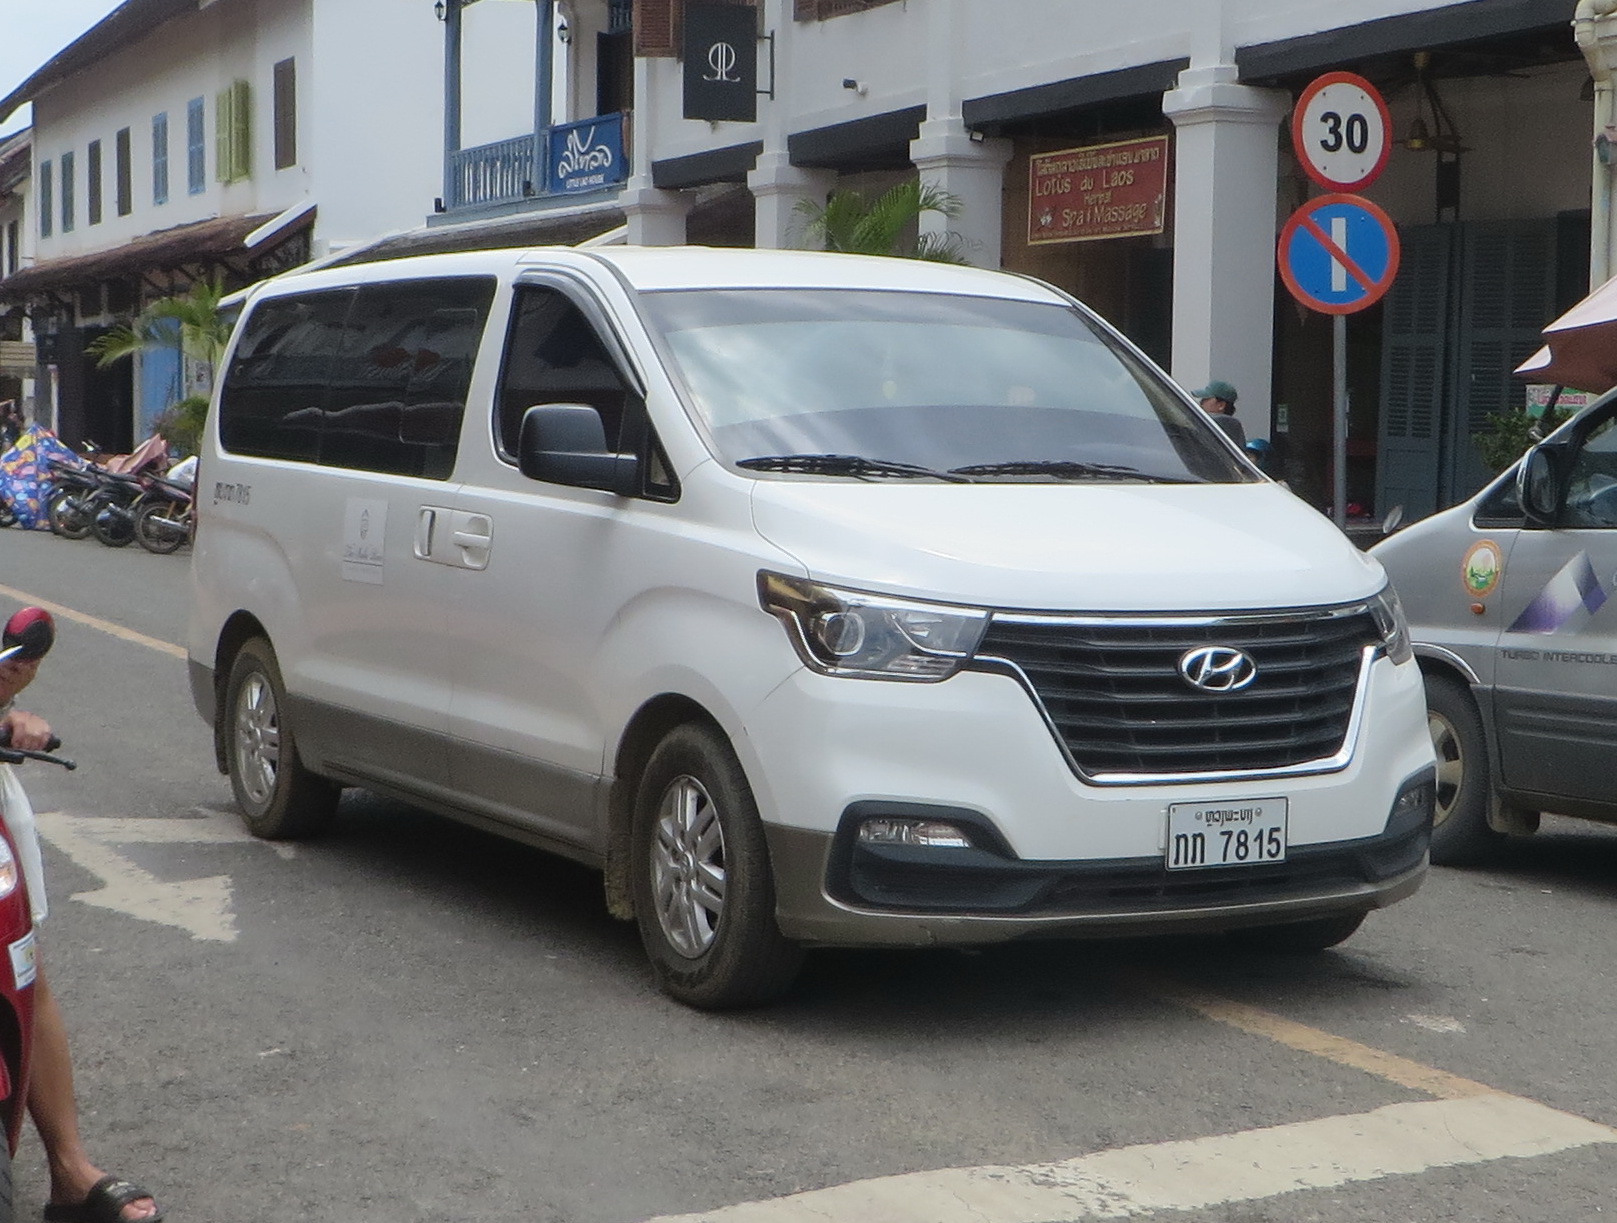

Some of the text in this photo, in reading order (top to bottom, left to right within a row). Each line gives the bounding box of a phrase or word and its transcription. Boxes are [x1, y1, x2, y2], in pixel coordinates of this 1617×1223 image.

[1320, 111, 1369, 154] 30
[1036, 175, 1072, 197] Lotus
[1103, 169, 1134, 188] Laos
[1062, 208, 1084, 228] Spa
[1094, 202, 1147, 223] Massage
[1502, 650, 1540, 660] TURBO
[1219, 826, 1282, 862] 7815
